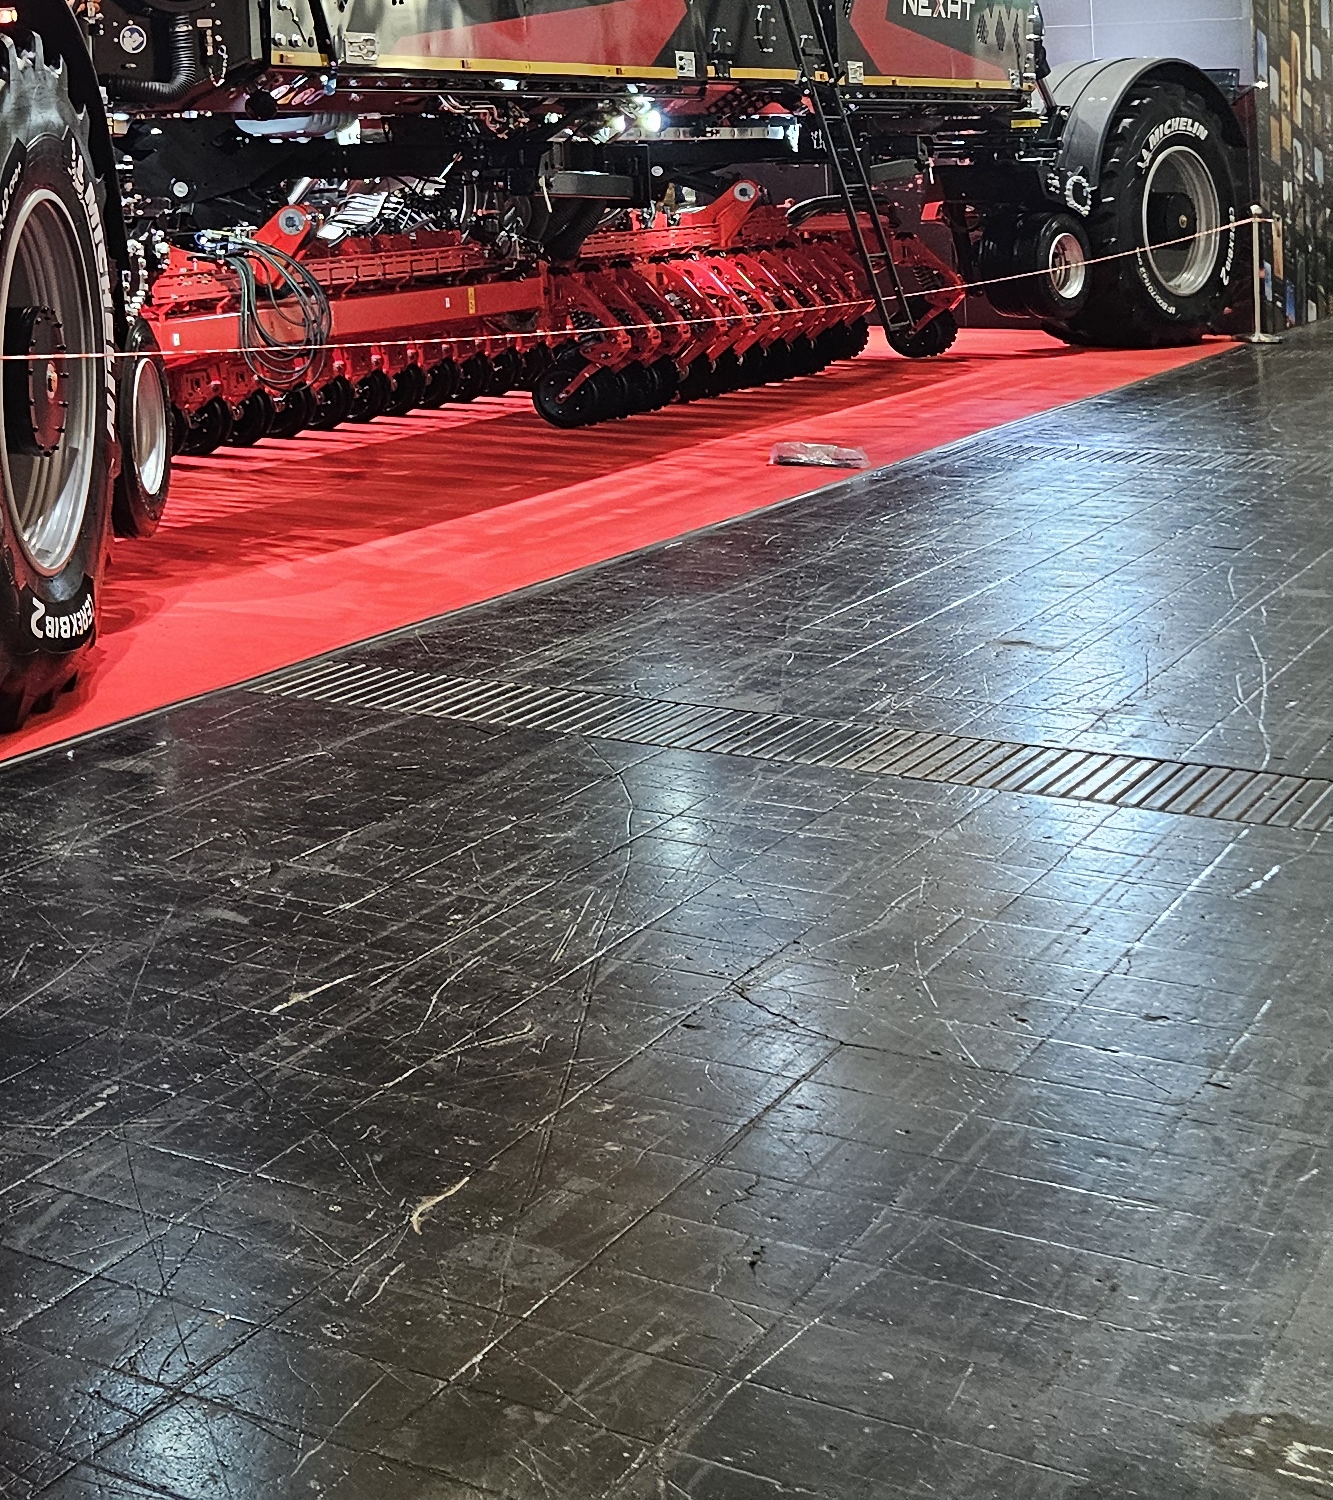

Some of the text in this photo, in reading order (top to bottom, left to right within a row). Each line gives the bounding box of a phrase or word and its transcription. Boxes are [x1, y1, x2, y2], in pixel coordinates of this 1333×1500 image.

[1148, 116, 1209, 150] MICHELIN
[1219, 265, 1232, 287] 2
[84, 181, 117, 442] MICHELIN
[30, 593, 95, 639] CEREXBIB 2
